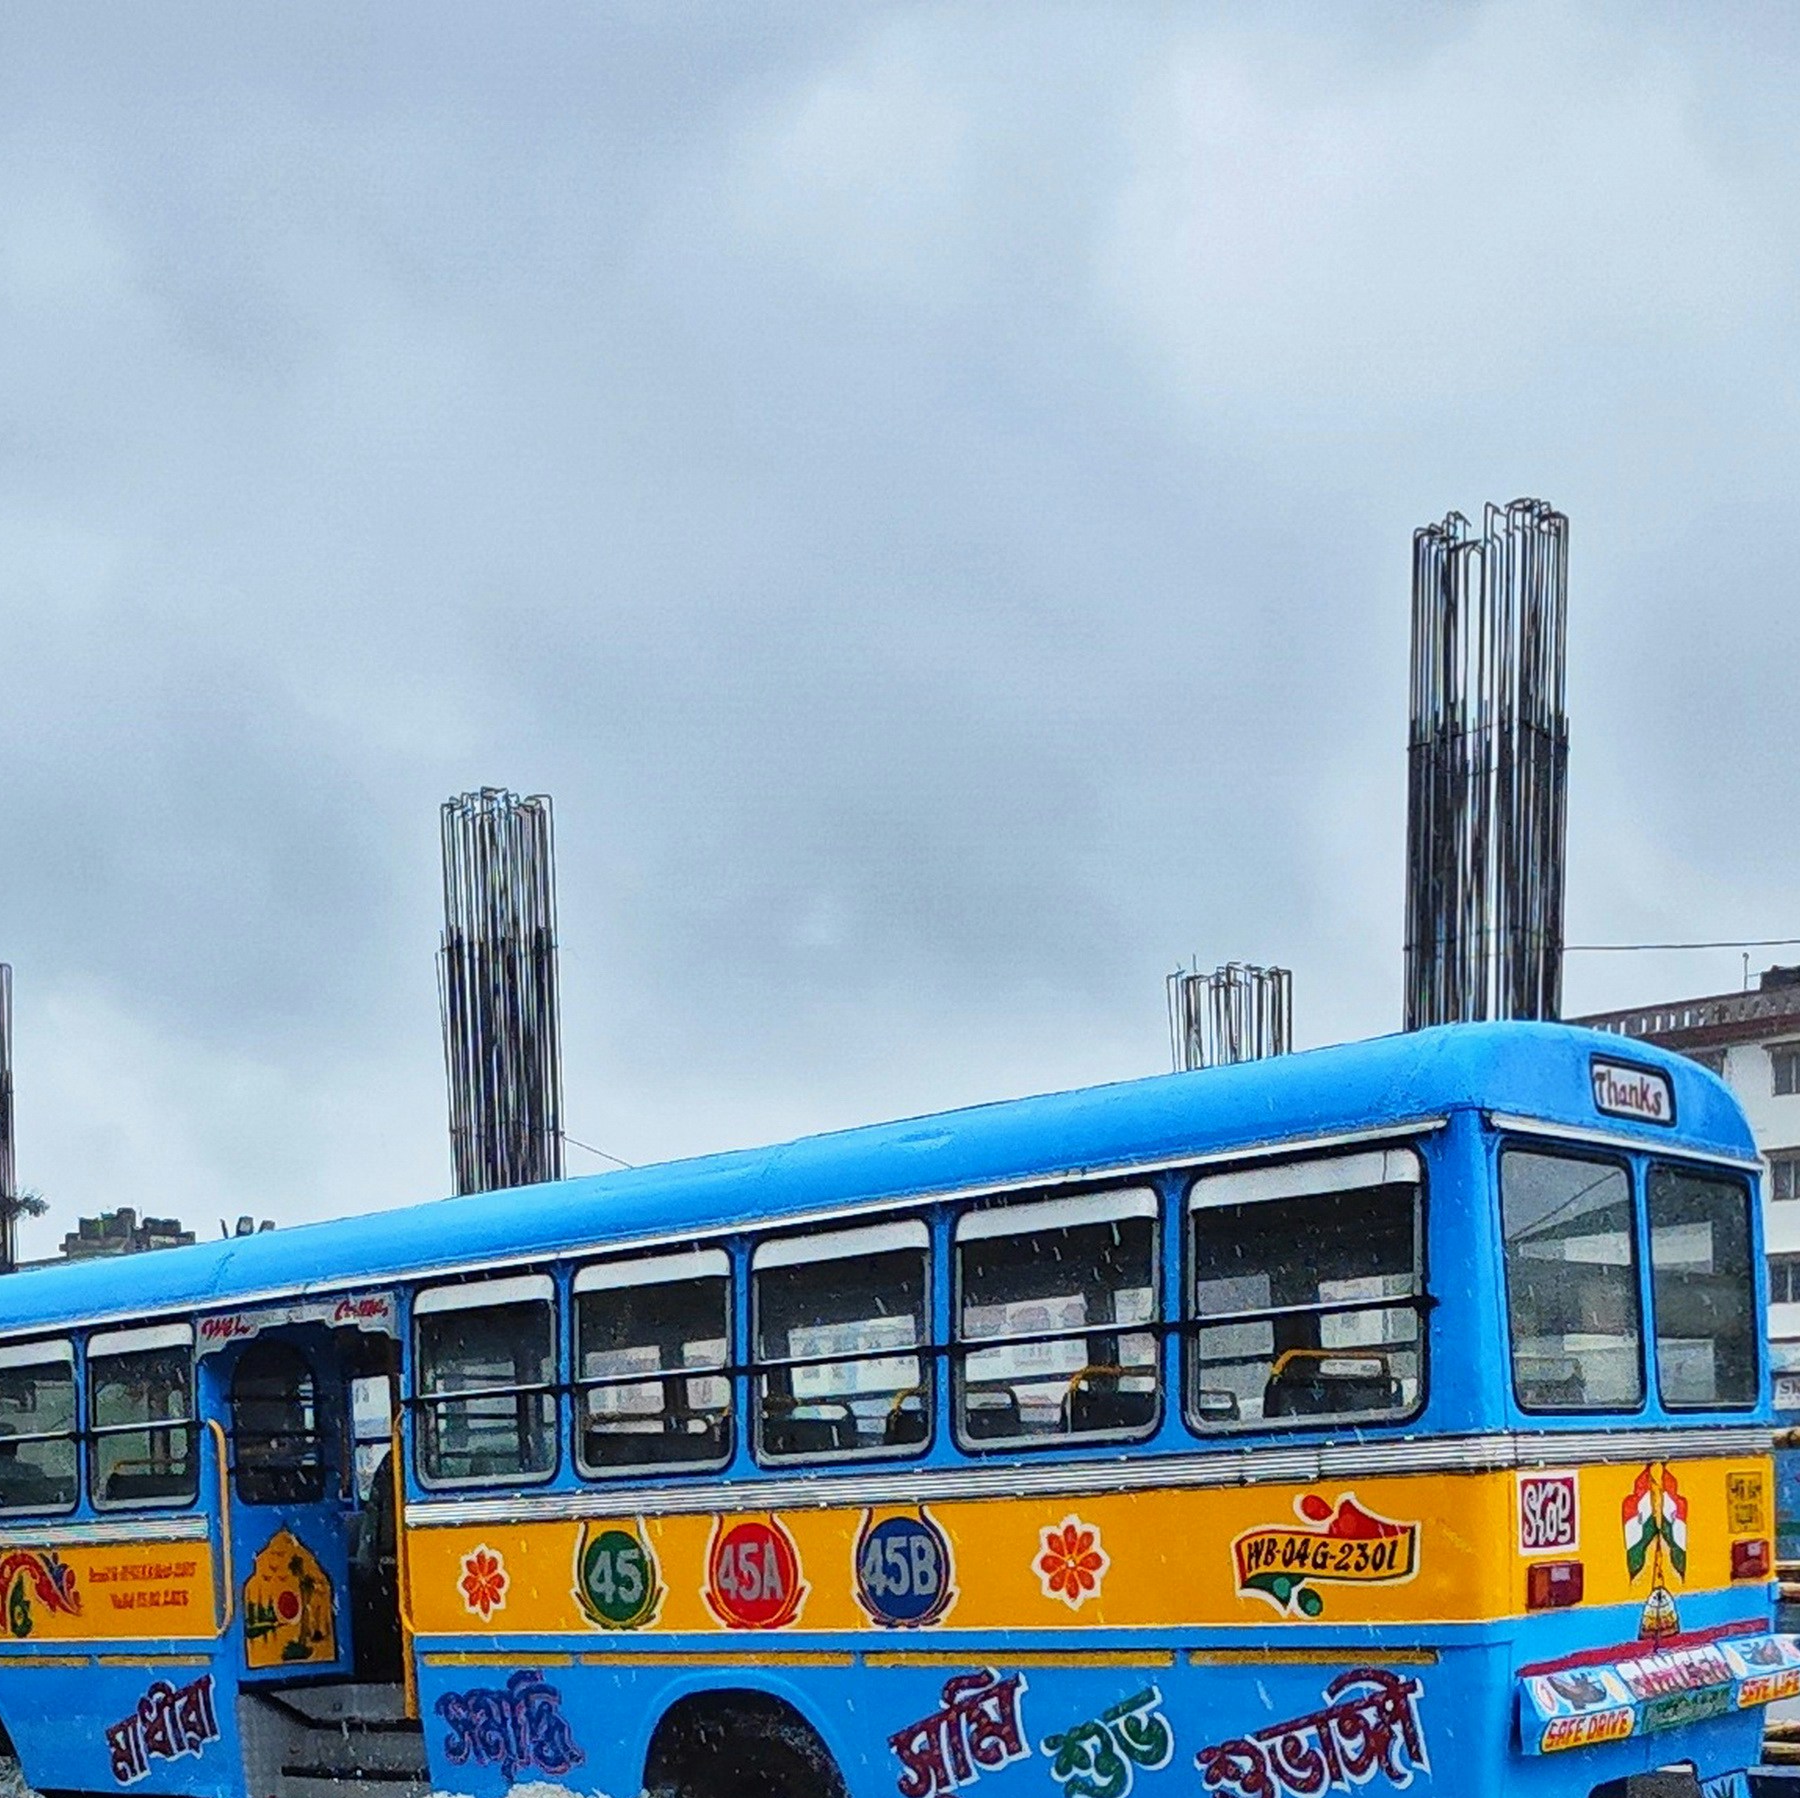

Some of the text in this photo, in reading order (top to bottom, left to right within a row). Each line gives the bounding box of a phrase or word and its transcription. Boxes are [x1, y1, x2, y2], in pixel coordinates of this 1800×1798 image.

[1594, 1070, 1662, 1116] Thanks
[588, 1548, 644, 1602] 45
[717, 1537, 785, 1604] 45A
[861, 1534, 940, 1600] 45B
[1545, 1709, 1630, 1749] SAFE DRIVE
